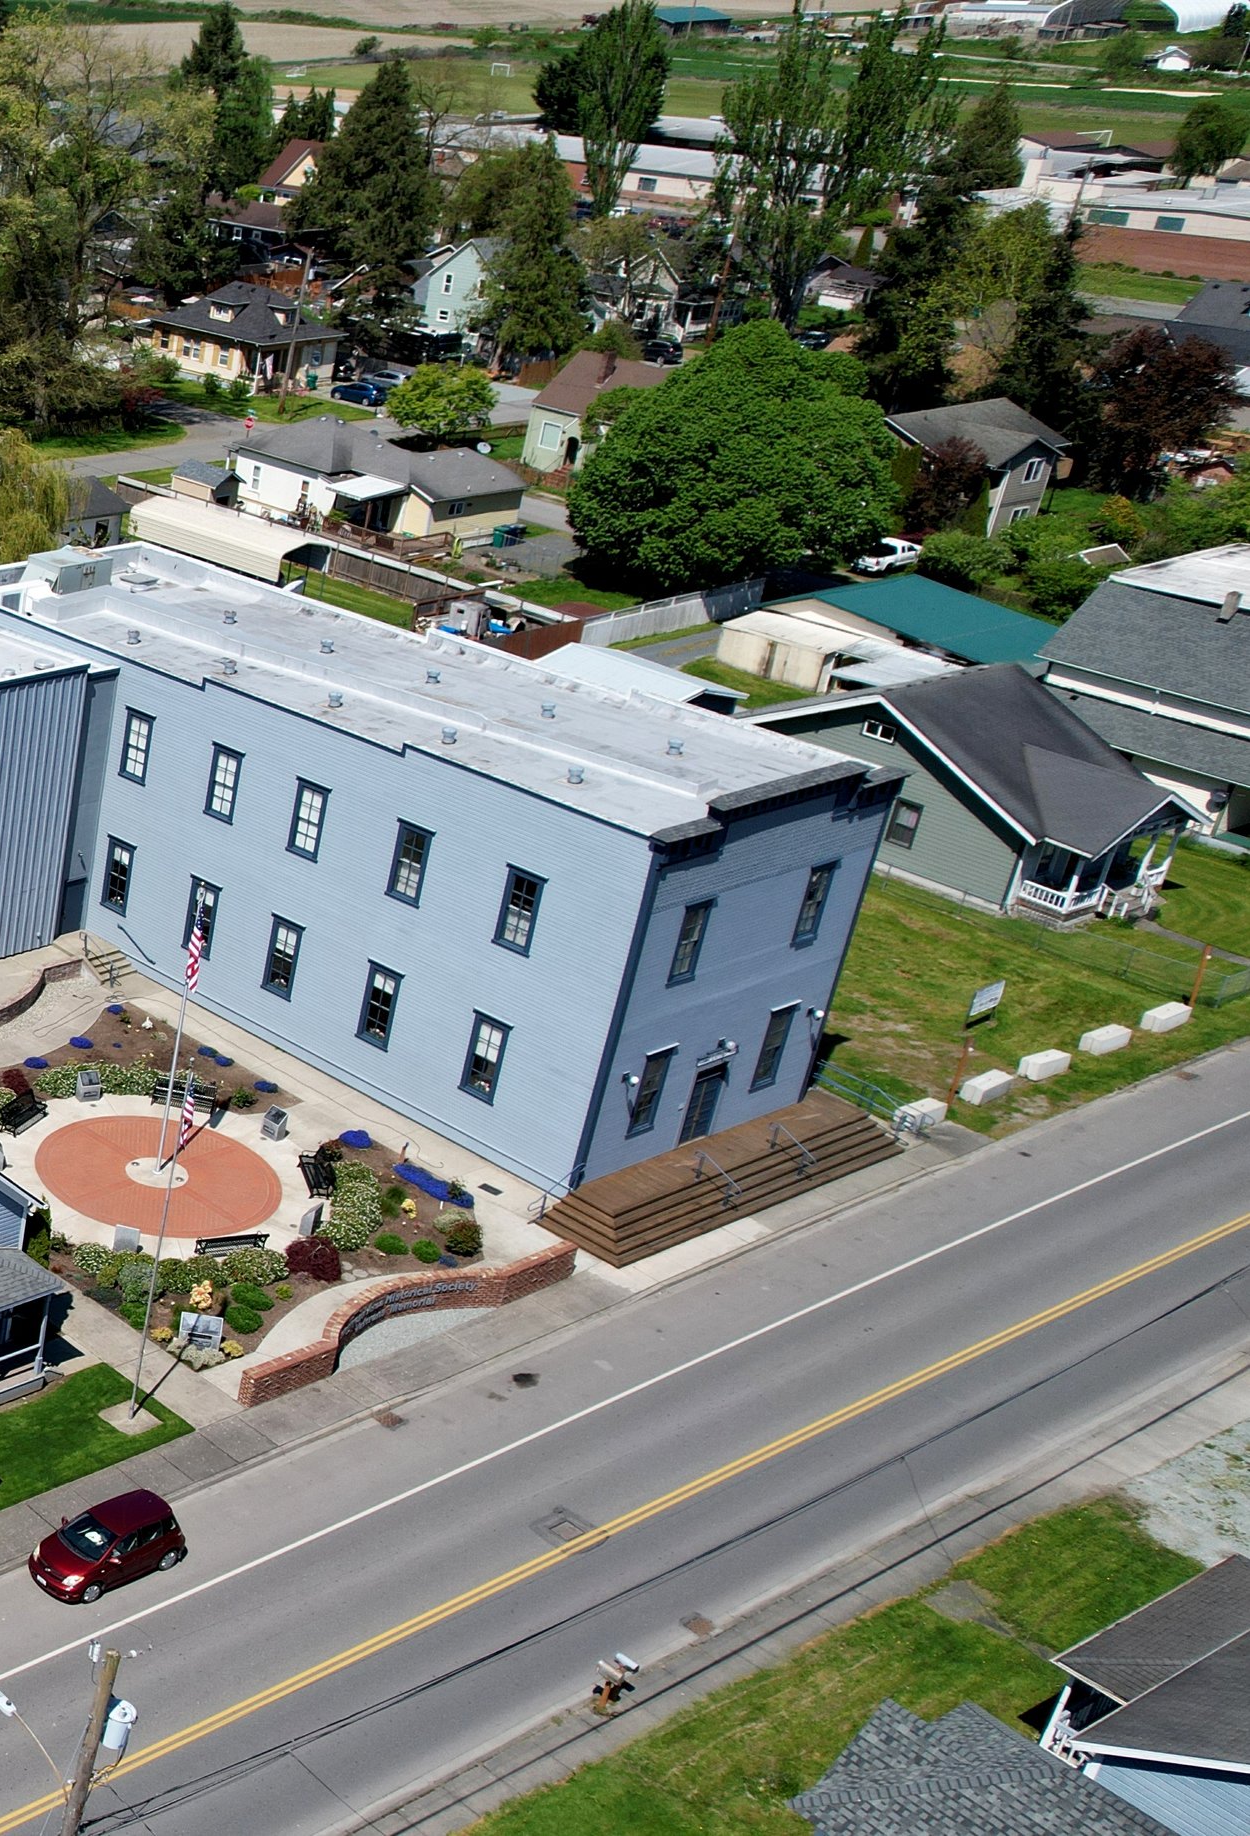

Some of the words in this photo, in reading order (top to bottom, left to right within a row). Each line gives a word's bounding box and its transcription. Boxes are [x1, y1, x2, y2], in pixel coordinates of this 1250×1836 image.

[385, 1287, 432, 1304] Historical
[434, 1280, 476, 1293] Society
[389, 1296, 436, 1313] Memorial
